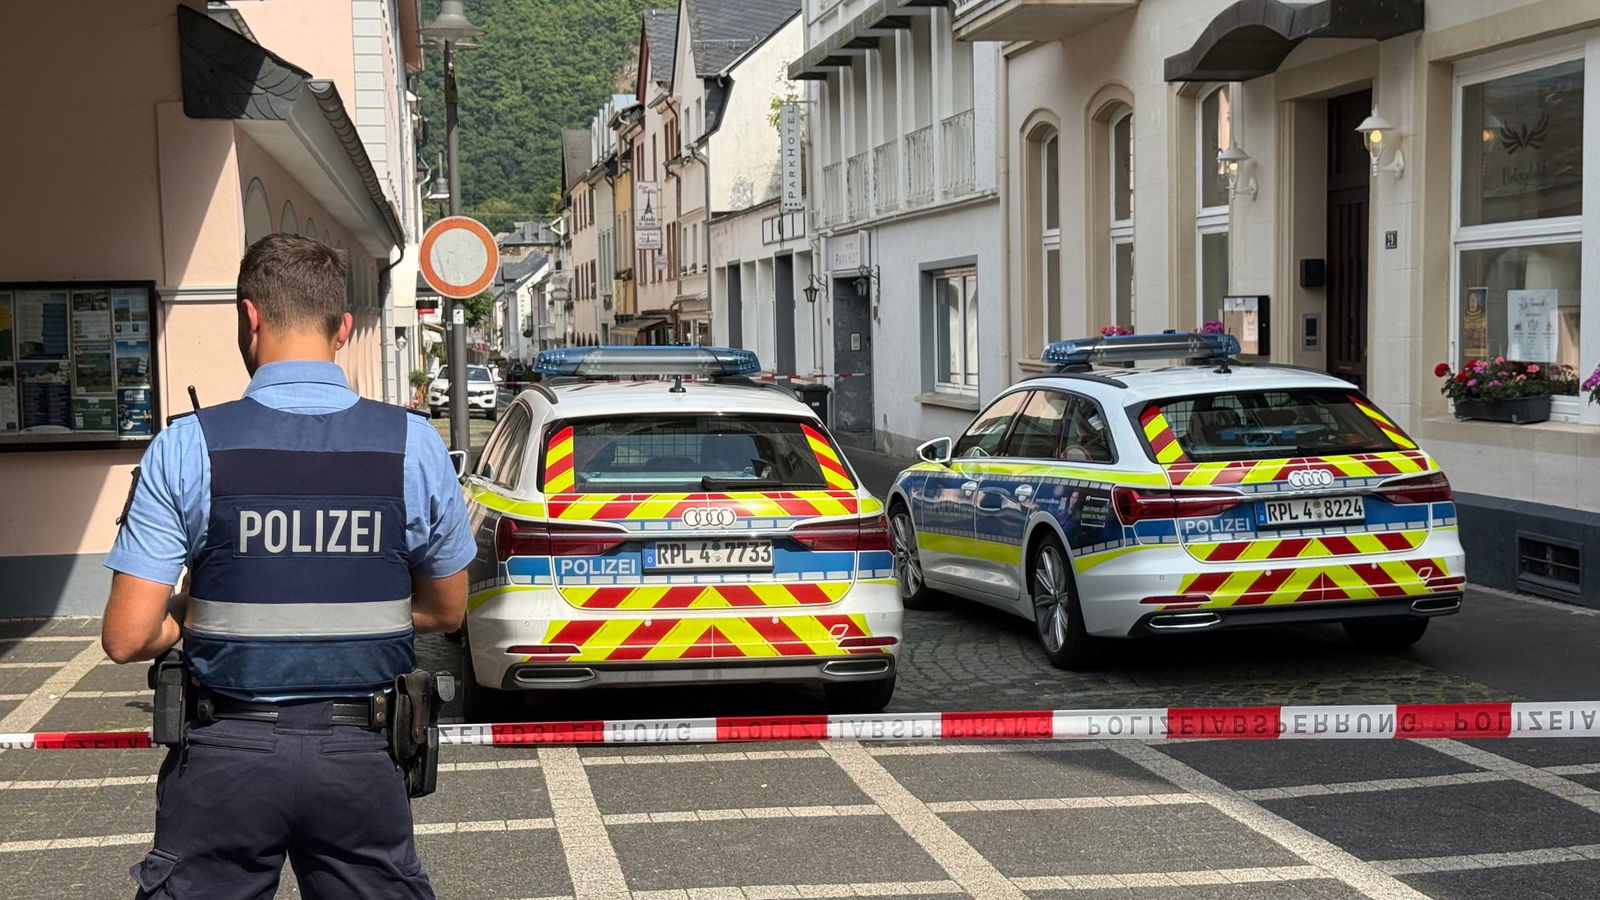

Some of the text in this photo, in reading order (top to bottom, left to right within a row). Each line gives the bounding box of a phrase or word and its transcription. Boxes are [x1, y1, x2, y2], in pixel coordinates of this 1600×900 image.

[787, 107, 796, 199] PARKHOTEL
[1267, 501, 1298, 522] RPL
[1303, 501, 1313, 519] 4
[1324, 498, 1363, 518] 8224
[239, 509, 382, 554] POLIZEI
[1184, 517, 1250, 534] POLIZEI
[657, 543, 694, 564] RPL
[700, 542, 711, 564] 4
[725, 541, 771, 563] 7733
[561, 559, 636, 575] POLIZEI
